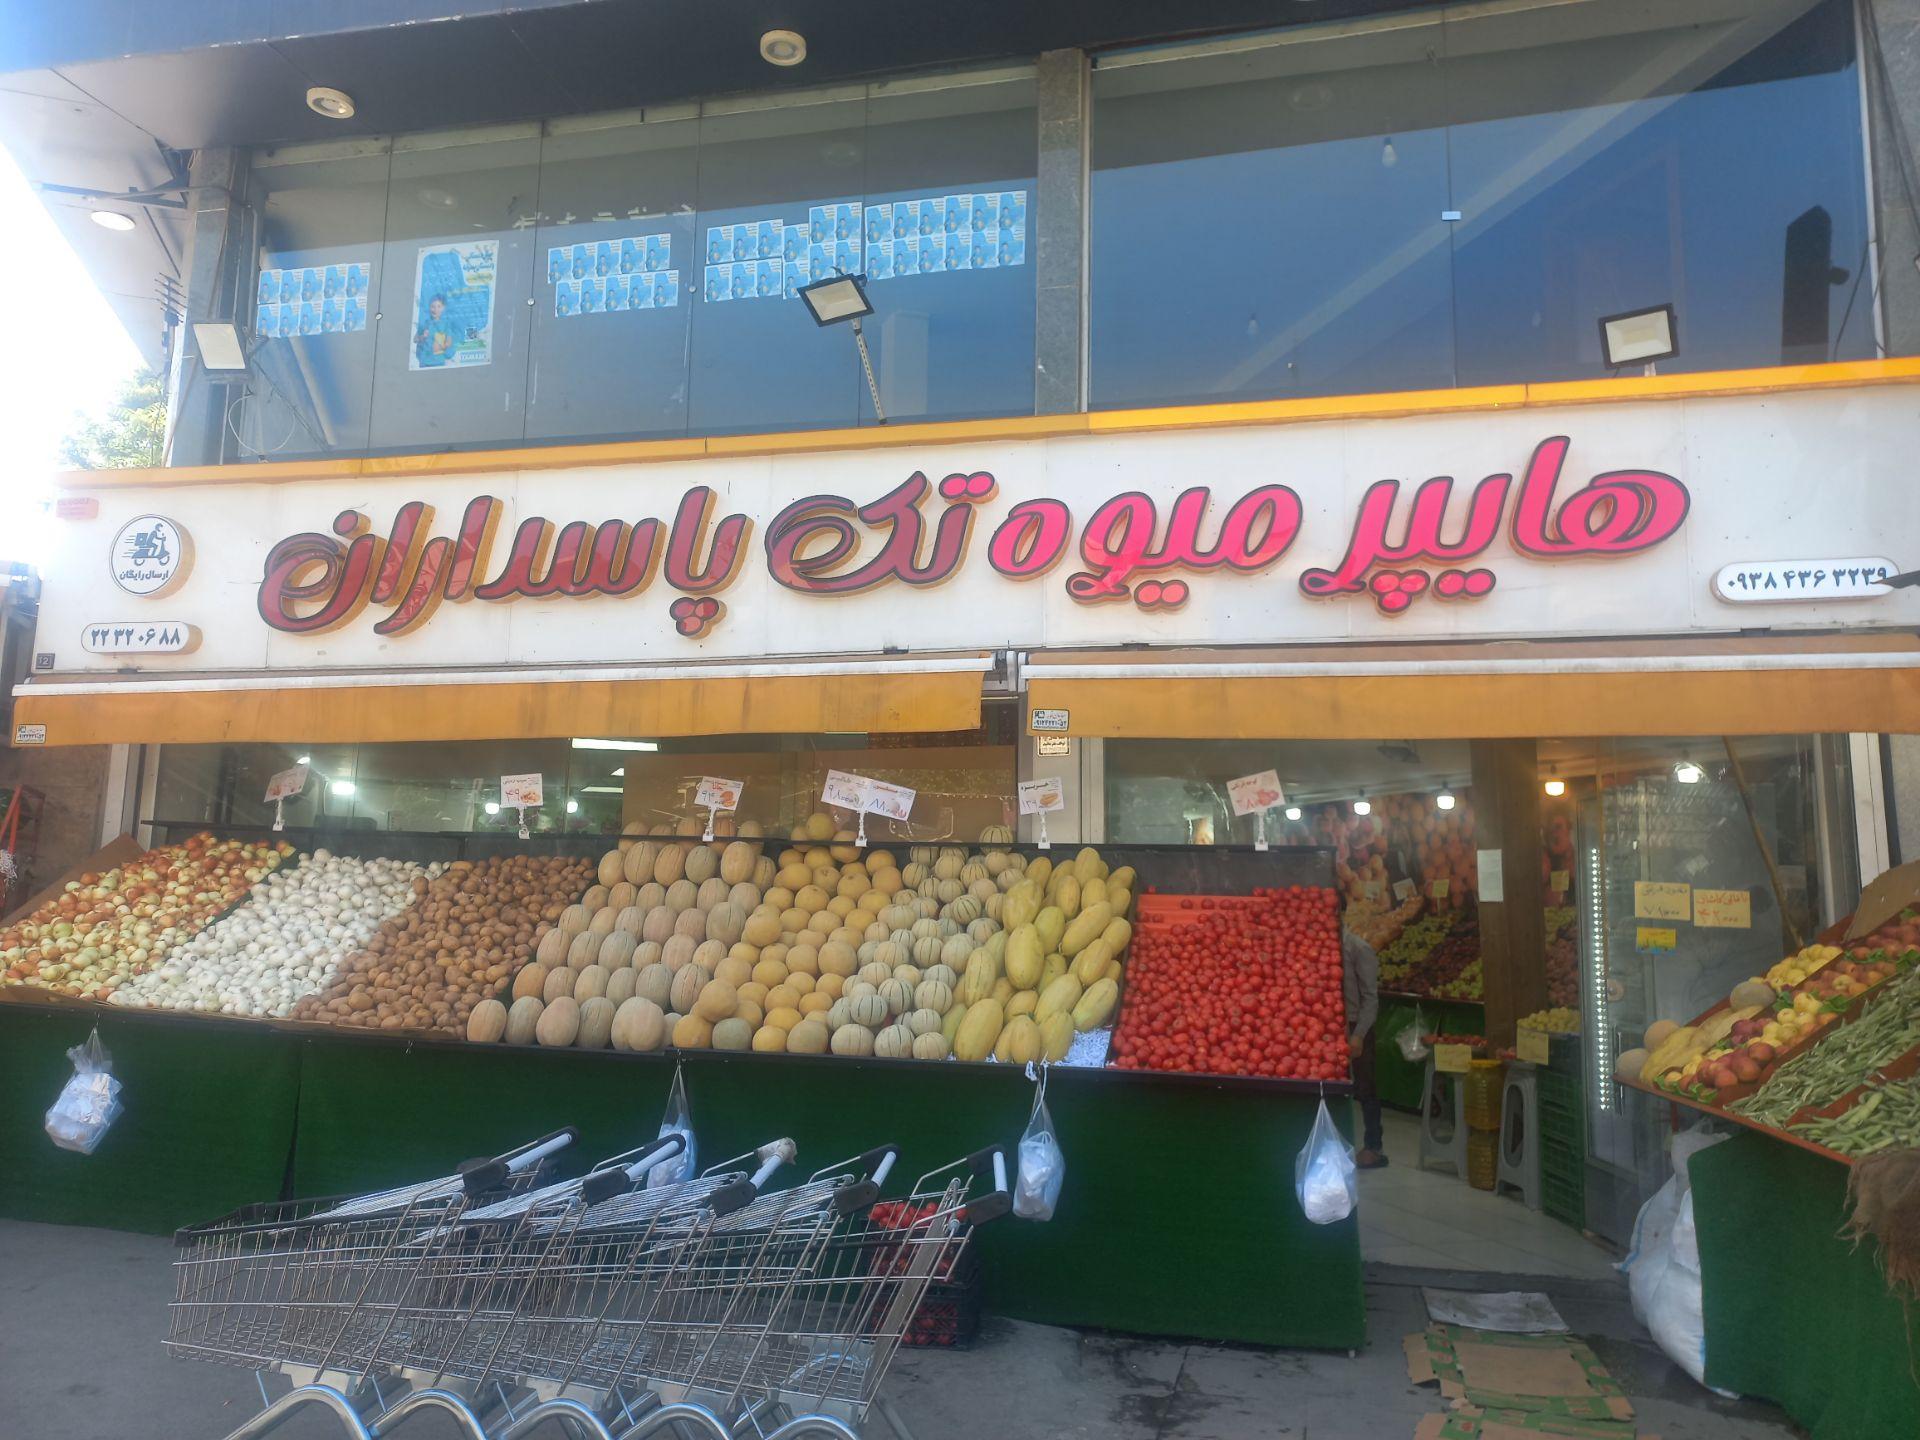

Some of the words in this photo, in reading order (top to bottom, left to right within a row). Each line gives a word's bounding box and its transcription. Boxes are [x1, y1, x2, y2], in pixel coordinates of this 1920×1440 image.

[1300, 435, 1691, 614] هایپر
[988, 484, 1303, 613] میوه
[119, 570, 145, 581] رایگان
[145, 569, 169, 580] ارسال
[1728, 571, 1777, 590] ۰۹۳۸
[1783, 569, 1826, 589] ۴۳۶
[1832, 566, 1887, 587] ۳۲۳۹
[91, 628, 109, 647] ۲۲
[113, 628, 134, 647] ۳۲
[138, 628, 156, 646] ۰۶
[158, 627, 180, 646] ۸۸
